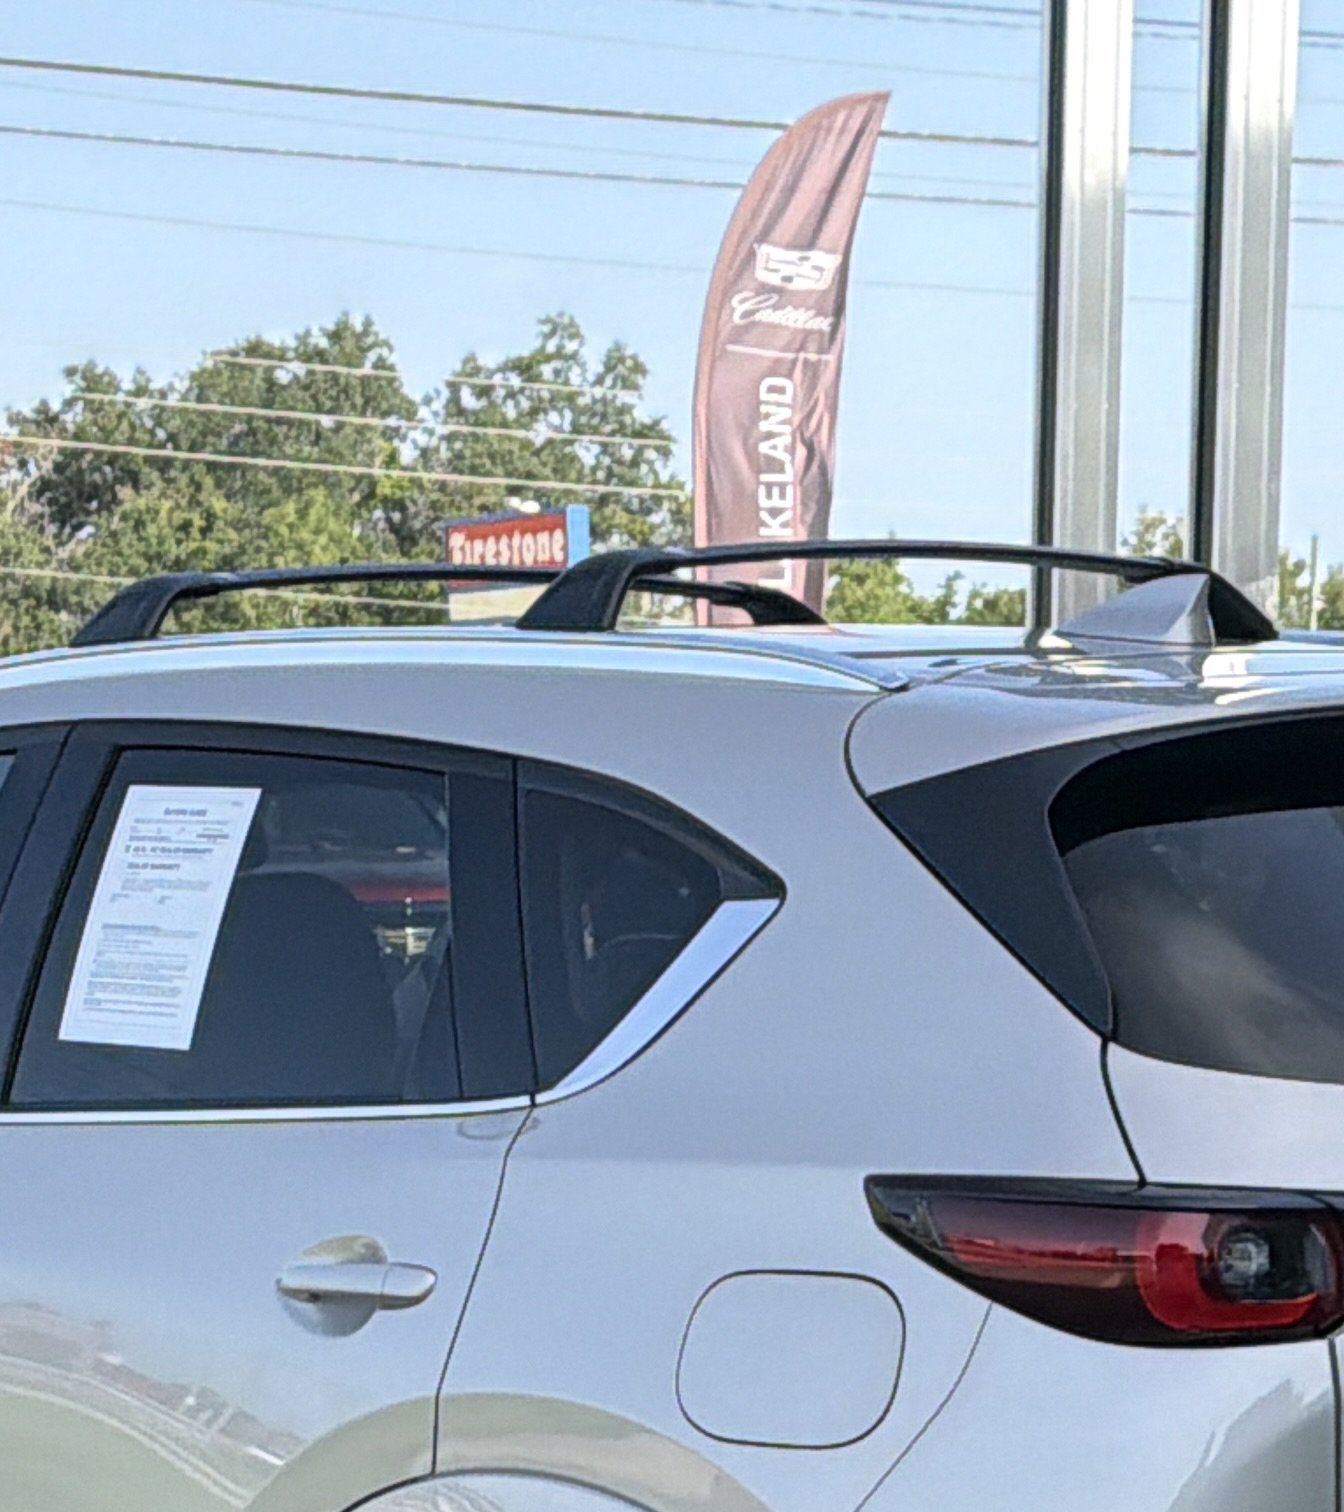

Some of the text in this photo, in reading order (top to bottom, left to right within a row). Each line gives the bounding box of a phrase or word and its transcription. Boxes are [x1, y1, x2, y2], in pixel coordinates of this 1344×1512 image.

[731, 291, 834, 332] Cadillac
[758, 376, 794, 590] LKELAND
[448, 528, 564, 567] Firestone
